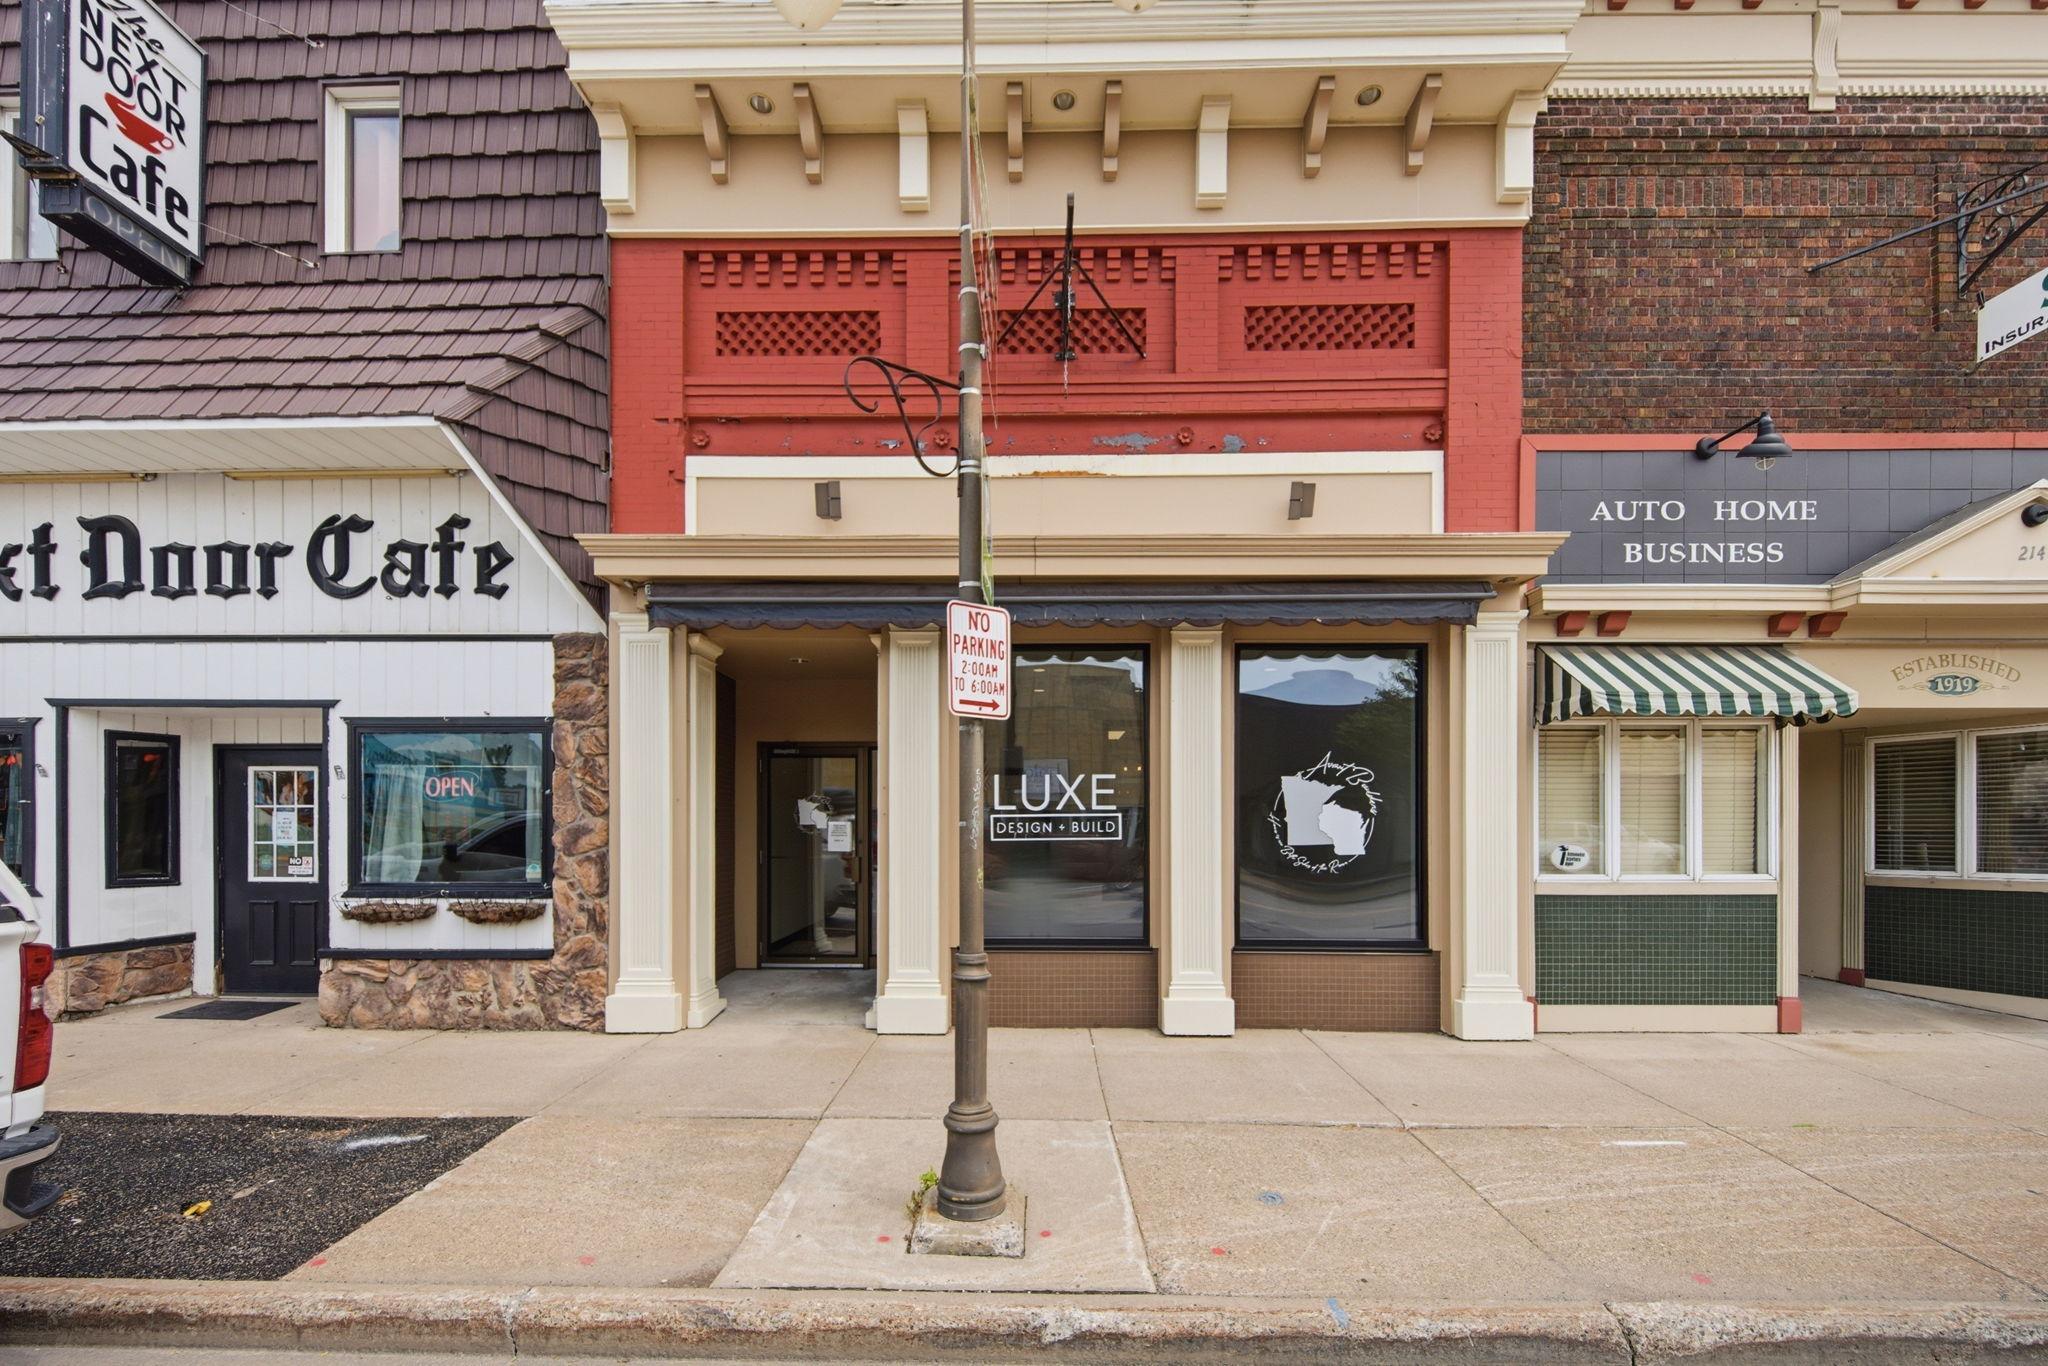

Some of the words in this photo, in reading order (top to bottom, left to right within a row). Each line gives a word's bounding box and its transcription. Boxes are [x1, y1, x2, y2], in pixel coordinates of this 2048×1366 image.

[80, 0, 187, 105] NEXT
[80, 27, 187, 147] DOOR
[79, 104, 189, 240] Cafe
[1985, 316, 2048, 354] INSUR
[1590, 500, 1686, 522] AUTO
[1713, 500, 1818, 522] HOME
[76, 514, 294, 600] Door
[305, 513, 514, 600] Cafe
[1623, 541, 1785, 564] BUSINESS
[2018, 545, 2046, 561] 214
[968, 610, 990, 632] NO
[953, 633, 1005, 660] PARKING
[962, 660, 998, 678] 2:00AM
[1890, 653, 2021, 685] ESTABLISHED
[955, 677, 965, 691] TO
[971, 680, 1005, 696] 6:00AM
[1935, 677, 1973, 692] 1919
[425, 776, 475, 798] OPEN
[993, 774, 1117, 811] LUXE
[996, 822, 1053, 834] DESIGN
[1071, 821, 1116, 833] BUILD
[289, 857, 302, 866] NO
